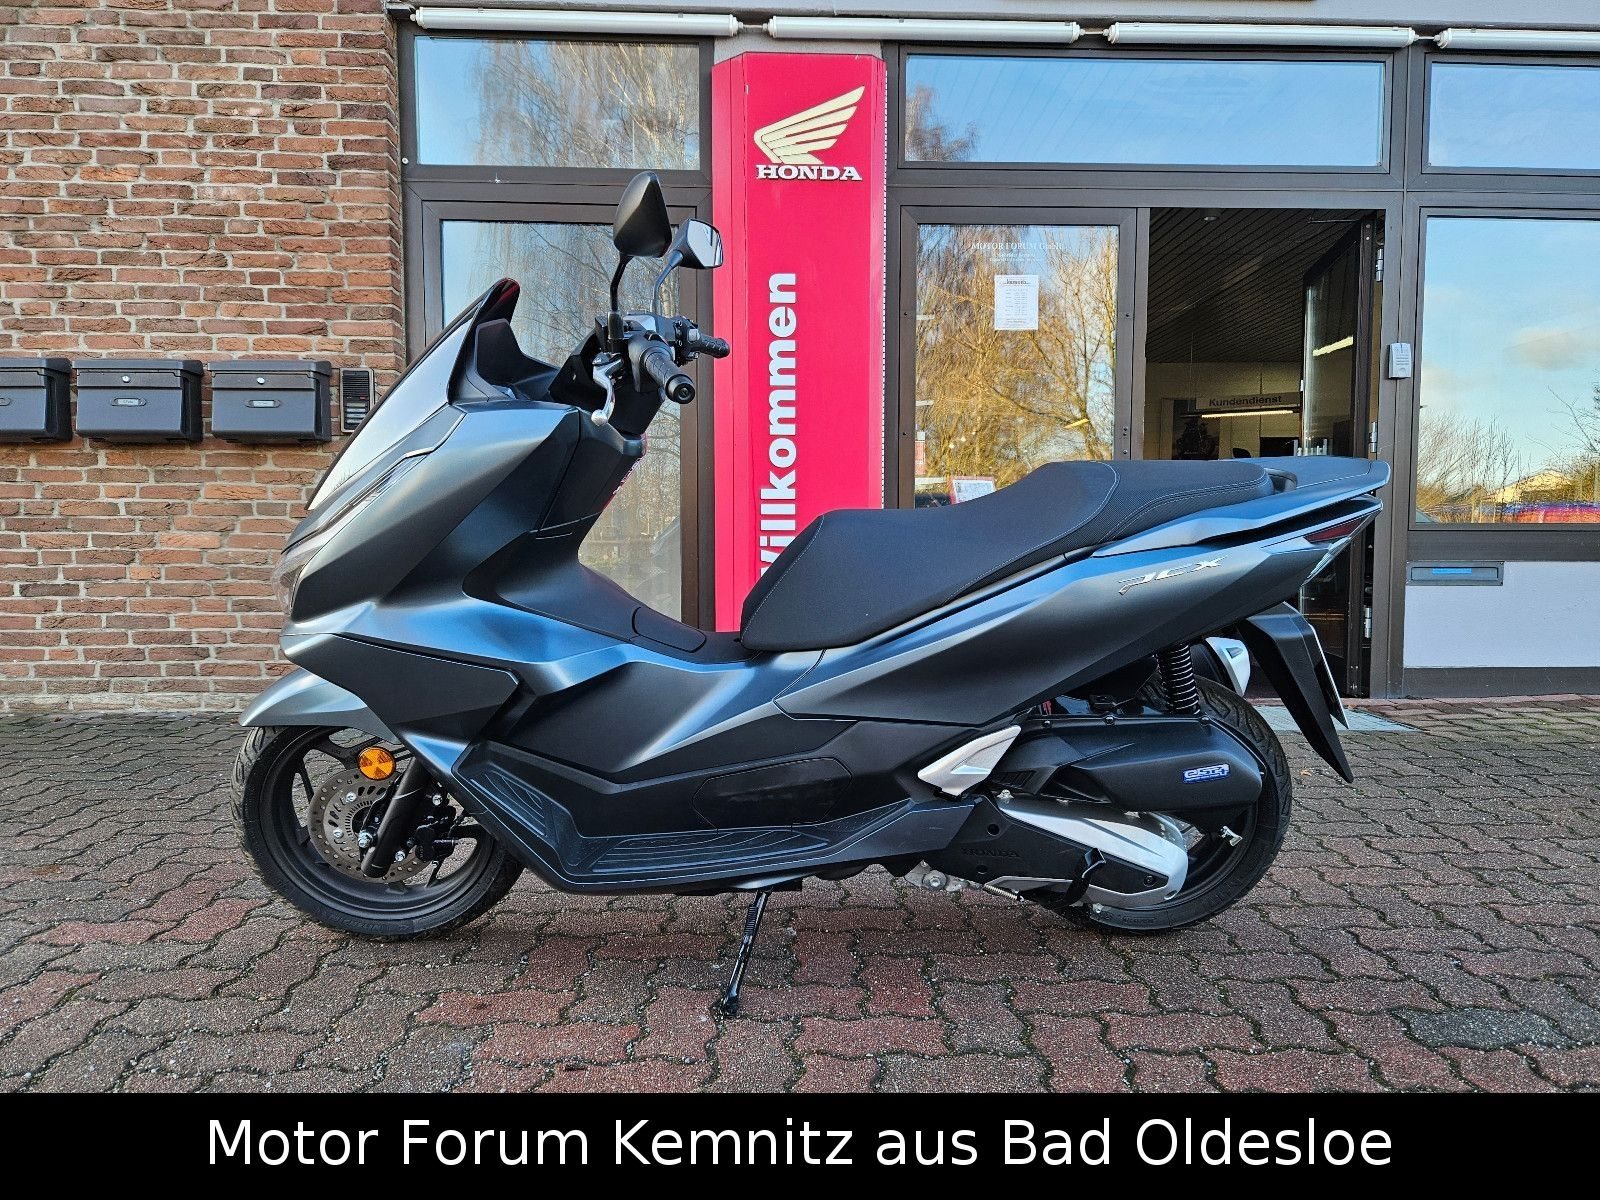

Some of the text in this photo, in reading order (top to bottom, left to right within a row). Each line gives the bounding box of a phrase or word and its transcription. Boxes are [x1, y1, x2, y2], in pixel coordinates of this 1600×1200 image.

[756, 164, 863, 181] HONDA
[971, 241, 1004, 250] MOTOR
[1208, 395, 1282, 407] Kundendienst
[1117, 555, 1226, 596] PCX
